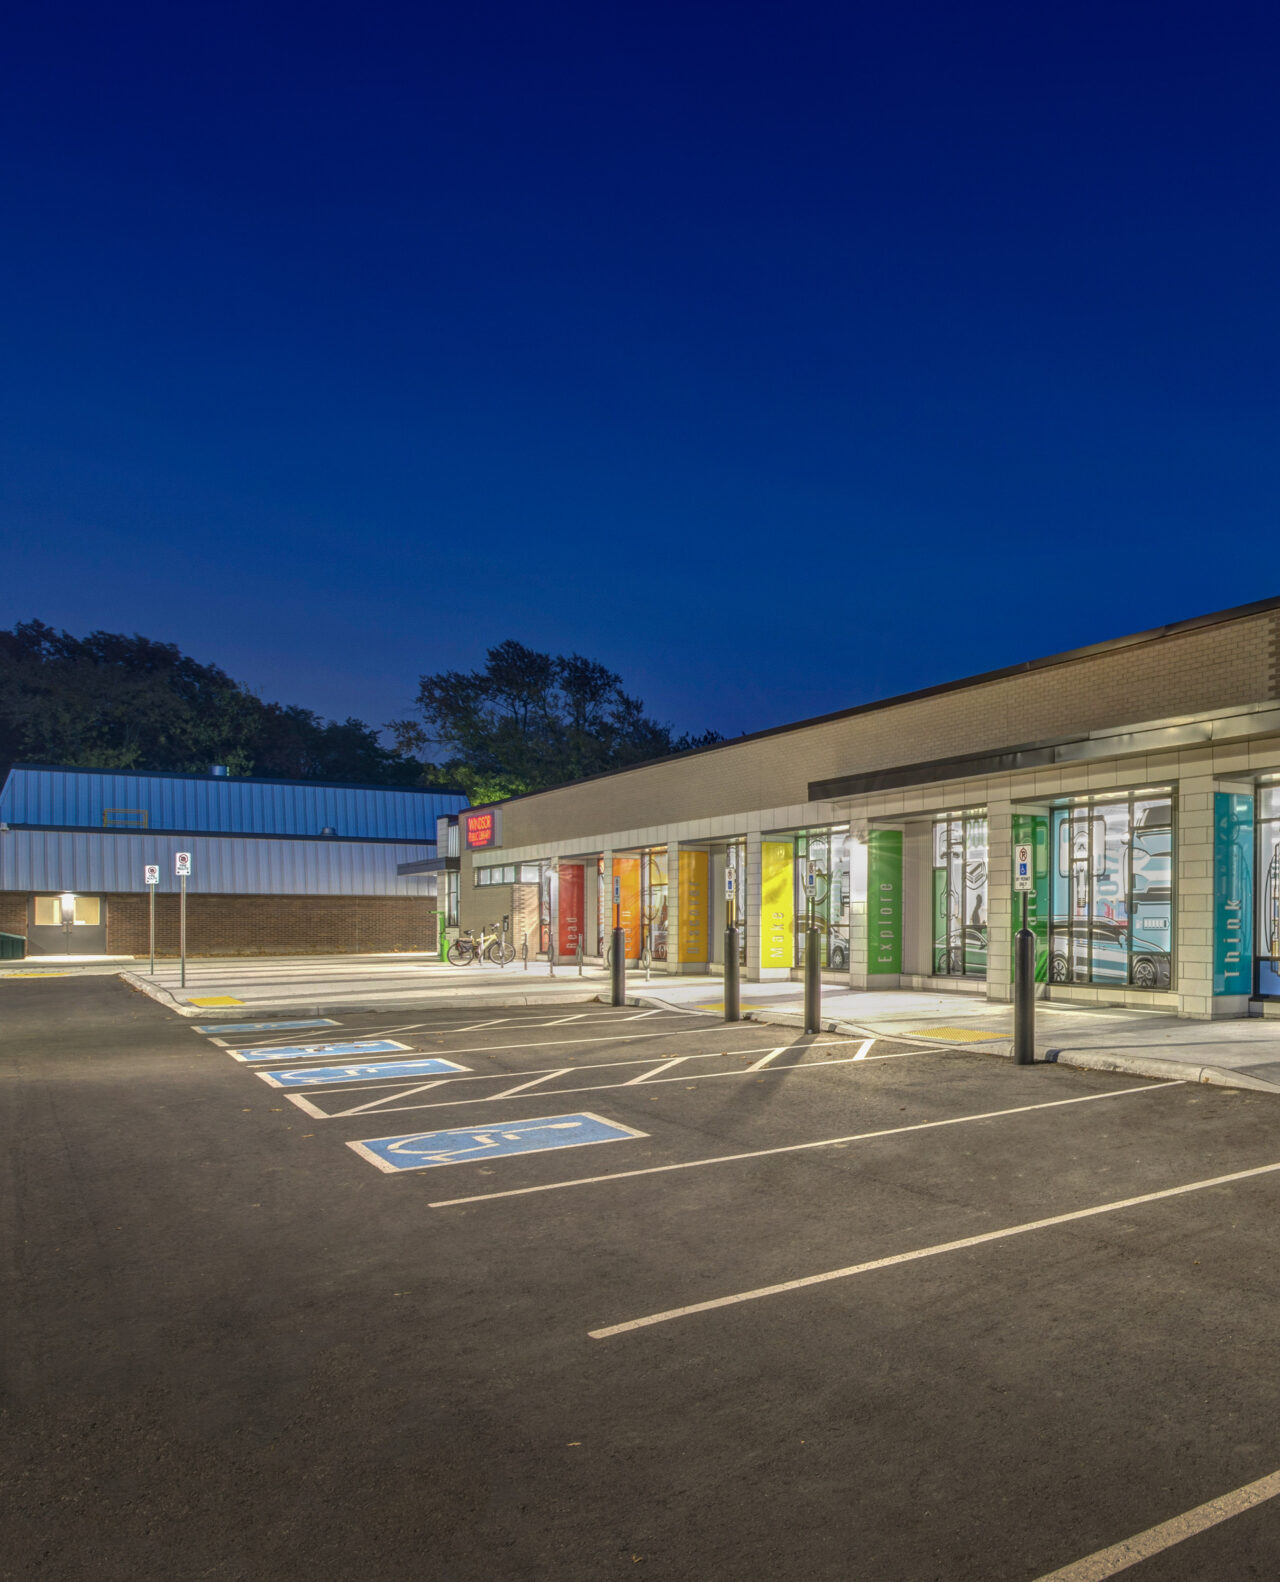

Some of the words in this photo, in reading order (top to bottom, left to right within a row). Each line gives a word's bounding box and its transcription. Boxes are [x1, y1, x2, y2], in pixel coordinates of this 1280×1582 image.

[566, 917, 577, 949] Read
[770, 912, 785, 958] Make
[878, 883, 894, 962] Explore
[1224, 899, 1242, 978] Think
